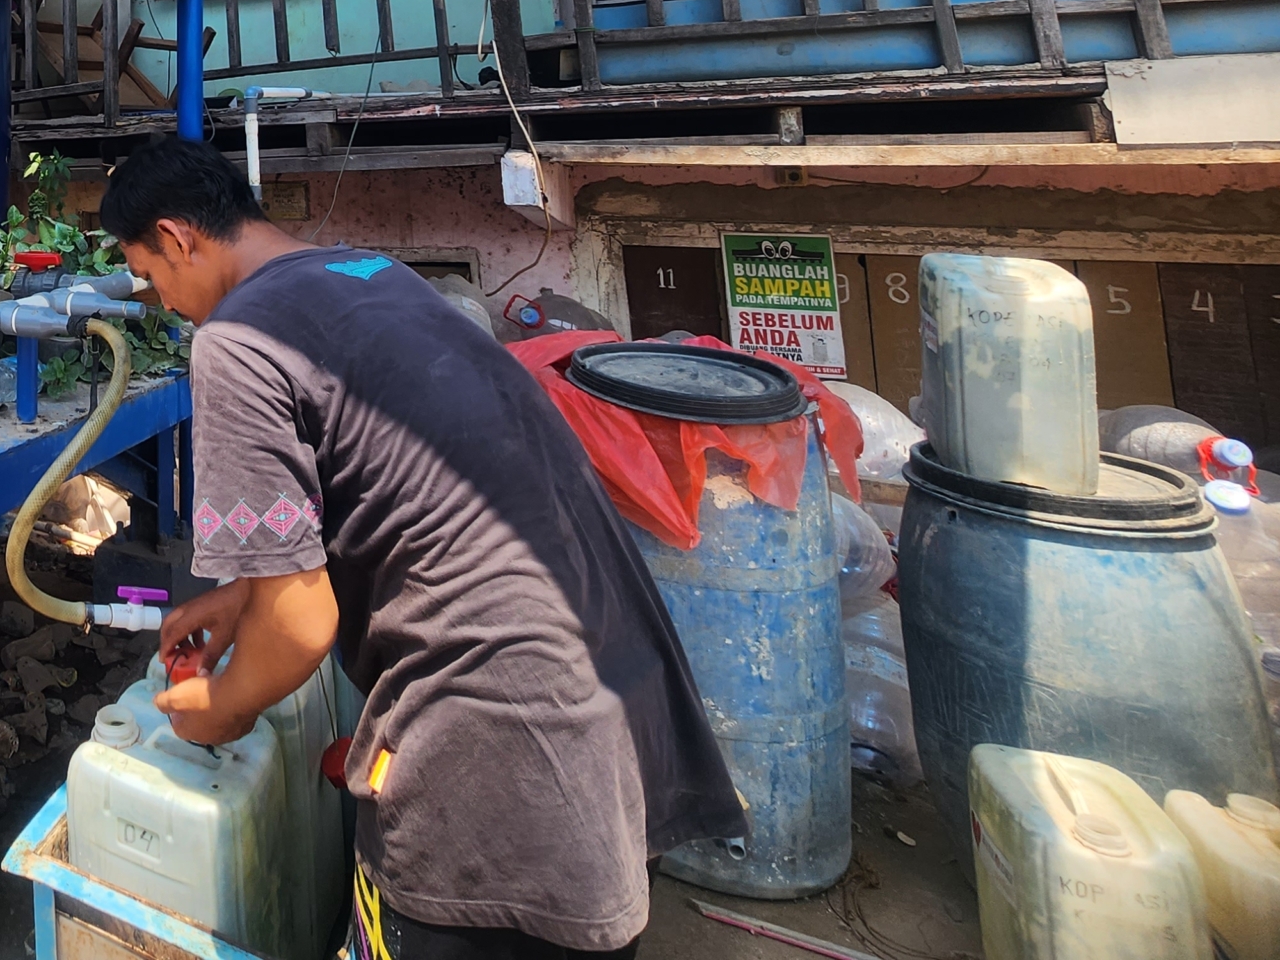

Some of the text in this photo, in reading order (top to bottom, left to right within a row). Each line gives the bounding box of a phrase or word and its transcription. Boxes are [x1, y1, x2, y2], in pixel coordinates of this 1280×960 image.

[656, 267, 677, 289] 11
[733, 263, 829, 280] BUANGLAH
[735, 276, 832, 298] SAMPAH
[885, 272, 910, 304] 8
[735, 294, 833, 308] PADA TEMPATNYA
[1106, 284, 1132, 315] 5
[1191, 290, 1215, 323] 4
[739, 311, 834, 331] SEBELUM
[739, 328, 801, 348] ANDA
[739, 344, 803, 354] DIBUANG BERSAMA
